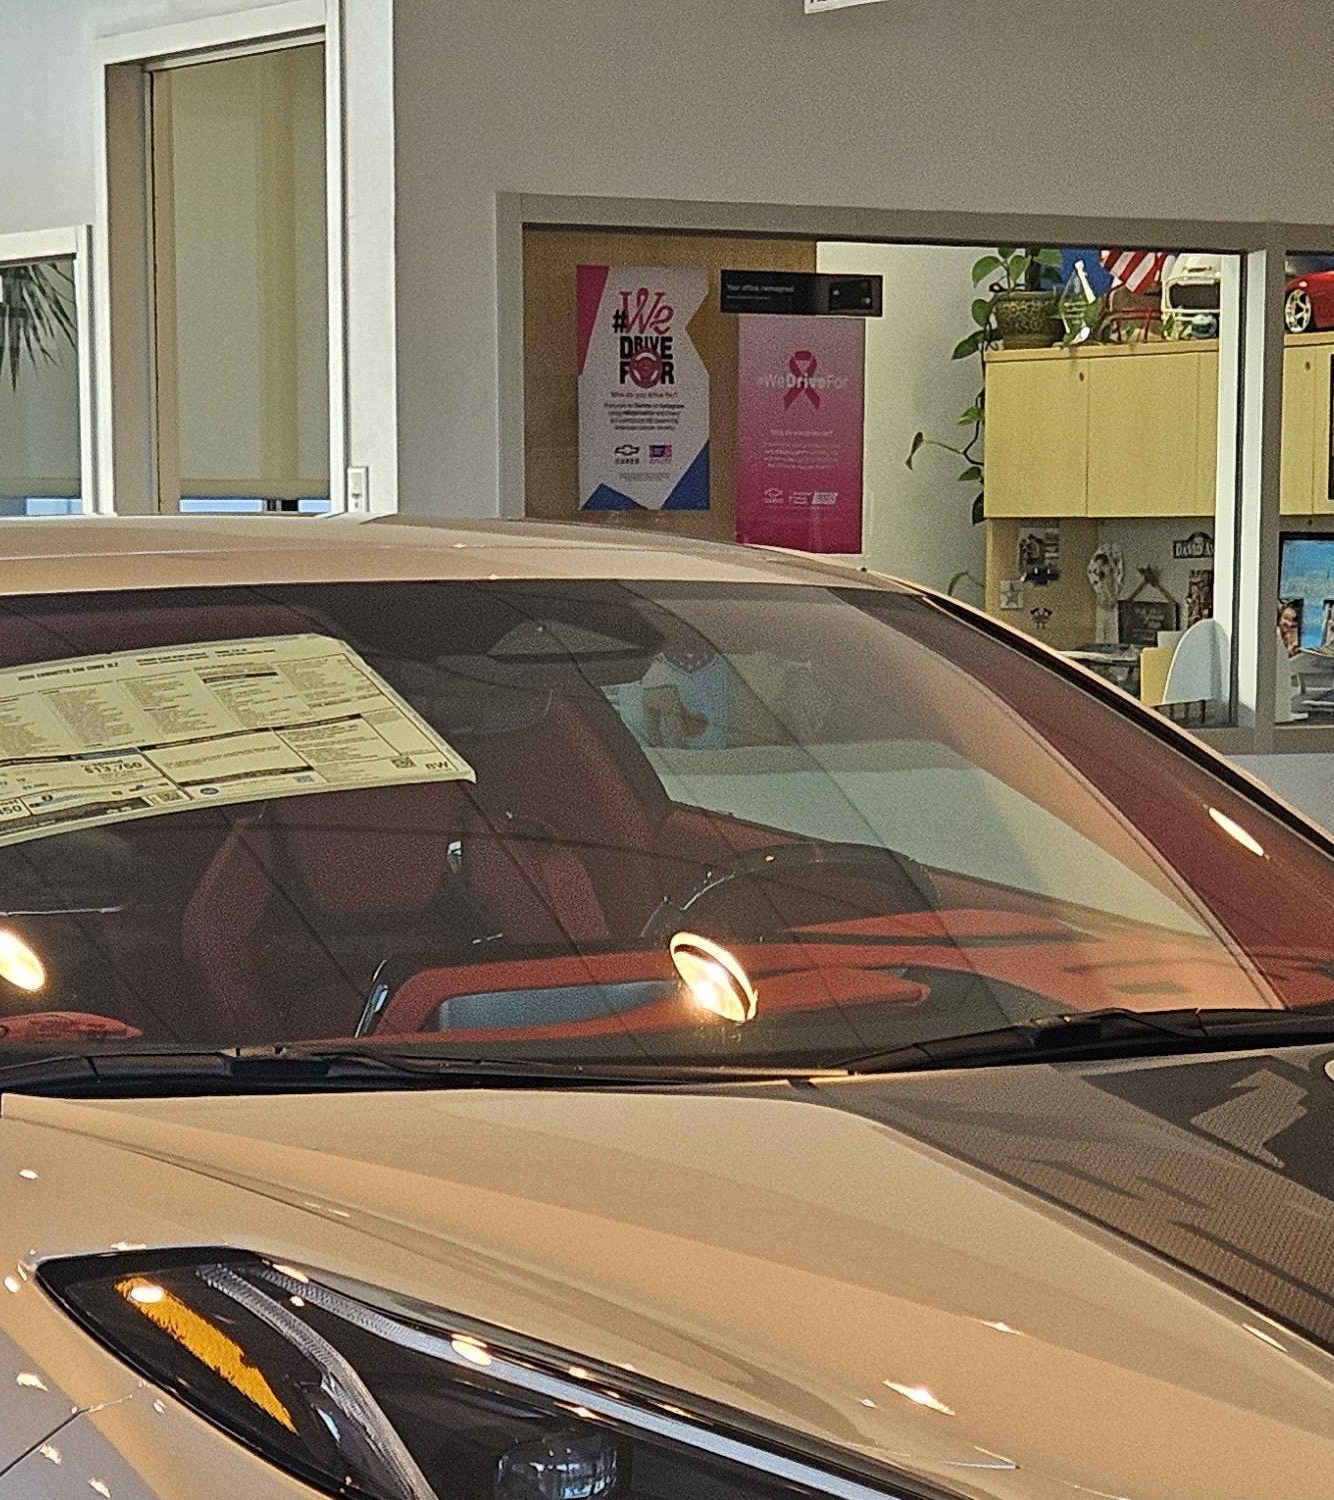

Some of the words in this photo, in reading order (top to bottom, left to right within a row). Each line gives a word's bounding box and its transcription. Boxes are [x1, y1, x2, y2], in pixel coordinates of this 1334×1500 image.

[612, 287, 674, 334] #We
[619, 335, 674, 360] DRIVE
[619, 360, 675, 388] FOR
